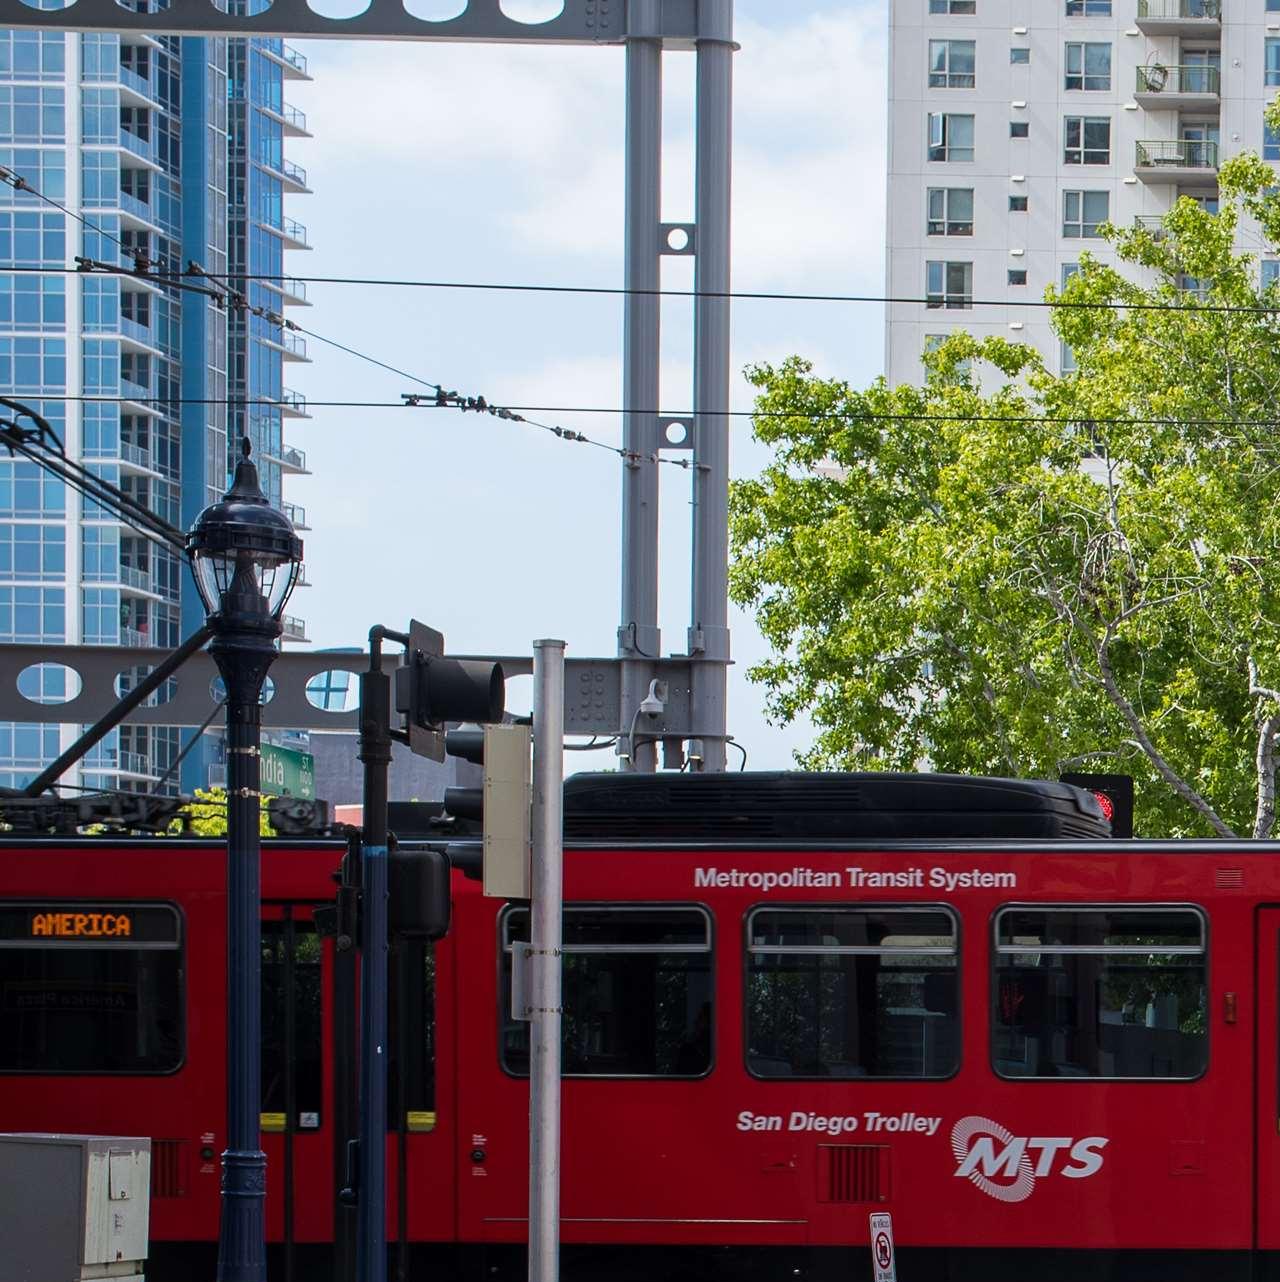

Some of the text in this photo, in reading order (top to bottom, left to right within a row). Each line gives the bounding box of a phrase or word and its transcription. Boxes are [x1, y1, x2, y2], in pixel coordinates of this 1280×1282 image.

[260, 753, 285, 786] ndia
[694, 867, 1017, 892] Metropolitan Transit System
[32, 913, 131, 936] AMERICA
[736, 1111, 942, 1136] San Diego Trolley
[952, 1136, 1109, 1179] MTS
